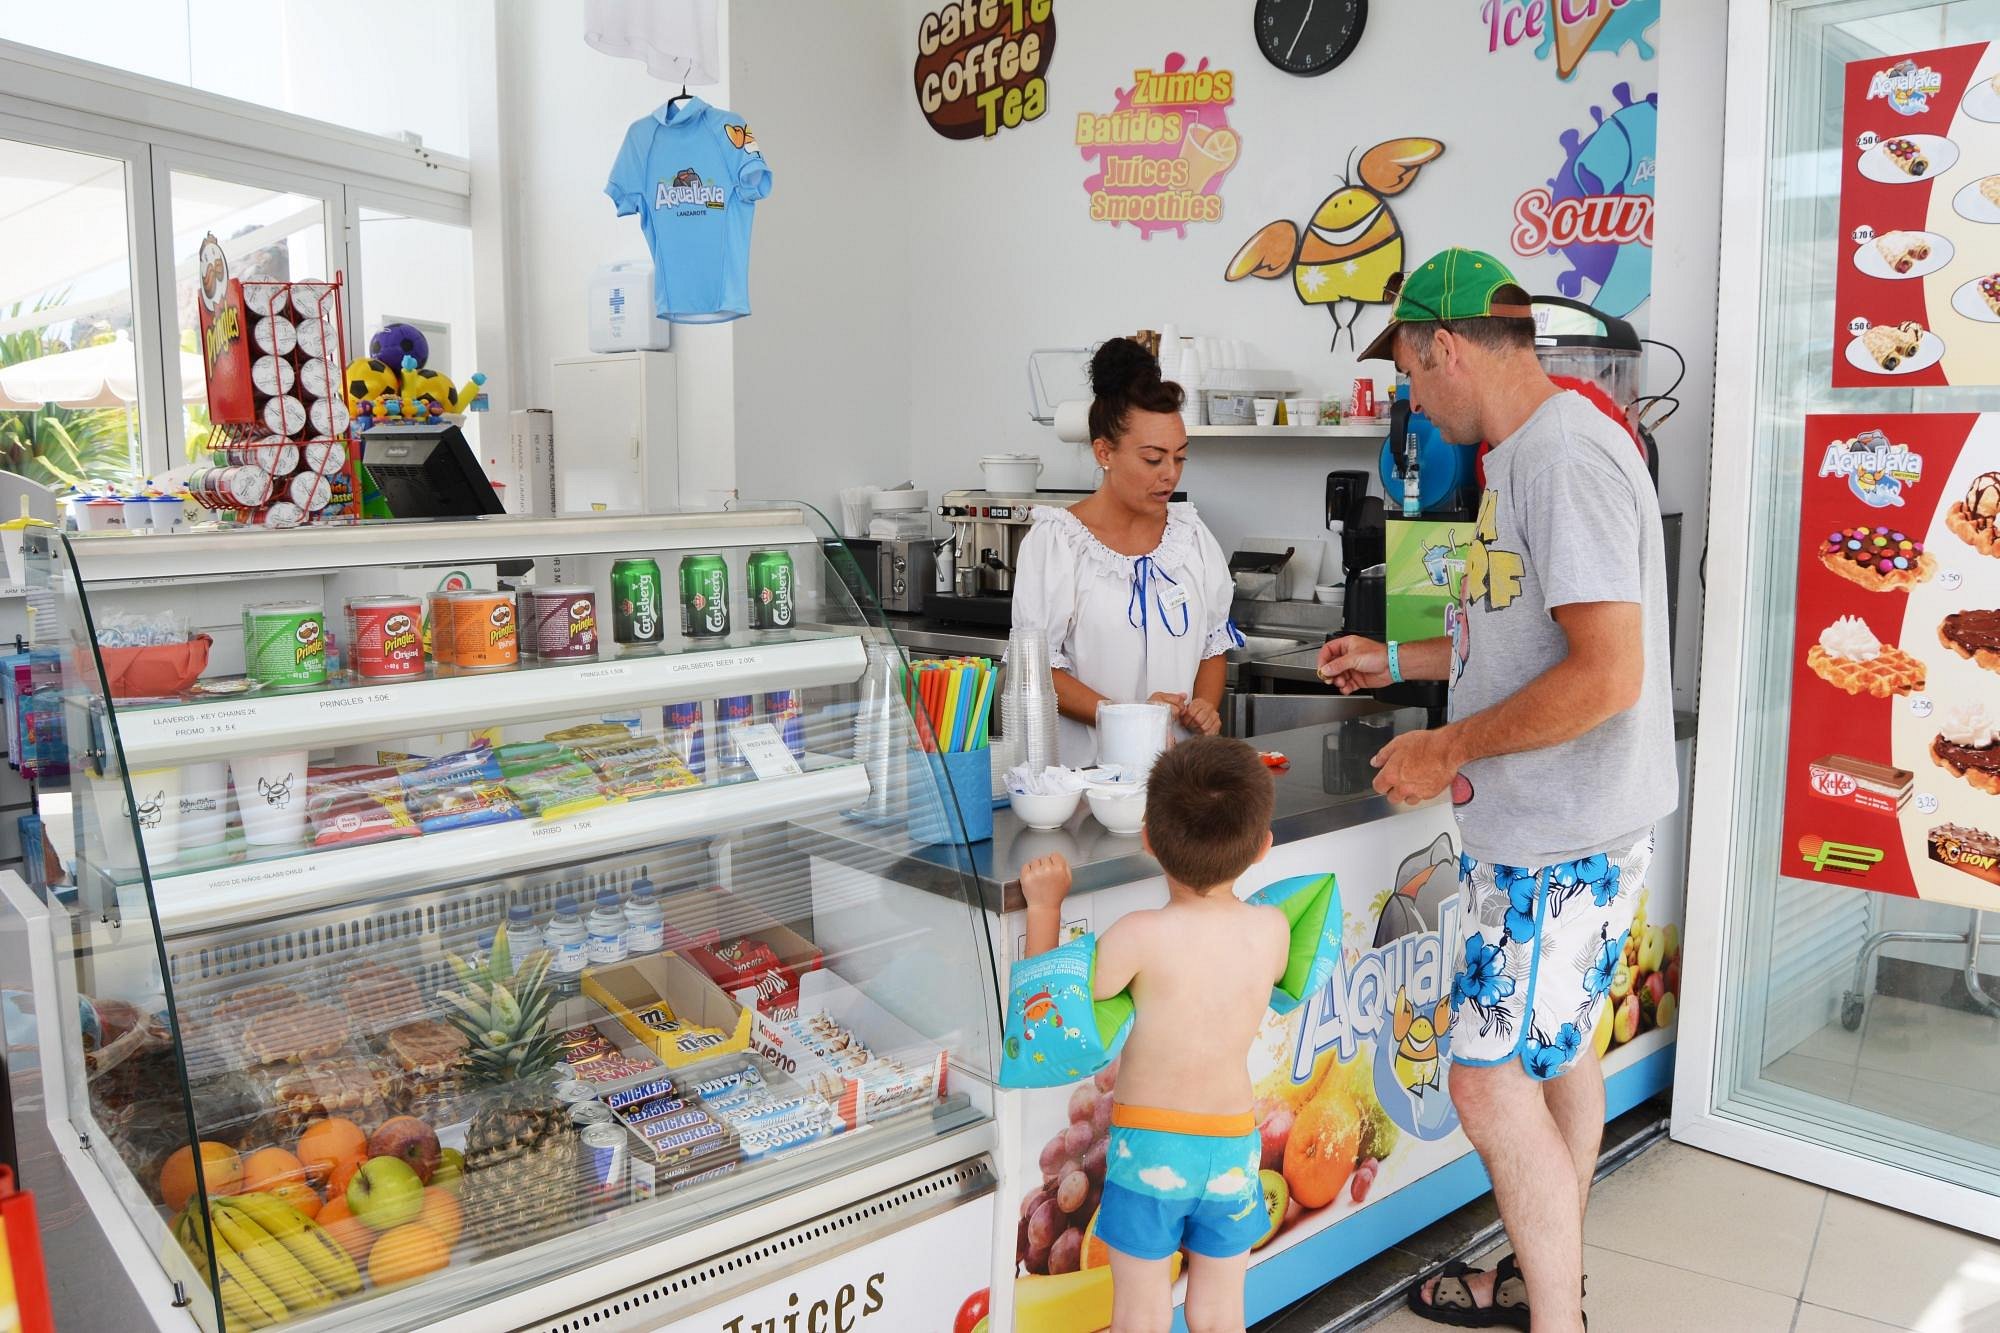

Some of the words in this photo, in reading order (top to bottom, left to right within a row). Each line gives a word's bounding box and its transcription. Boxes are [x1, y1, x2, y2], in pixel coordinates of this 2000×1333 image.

[1345, 2, 1351, 12] 3
[1268, 16, 1274, 26] 9
[1273, 36, 1279, 46] 8
[1325, 44, 1331, 54] 5
[1306, 54, 1312, 64] 6
[921, 33, 1041, 114] coffee
[1132, 69, 1234, 105] Zumos
[976, 77, 1047, 137] Tea
[1075, 110, 1182, 145] Batidos
[1104, 155, 1190, 187] Juices
[1091, 190, 1222, 222] Smoothies
[206, 300, 240, 379] Pringles
[634, 574, 657, 639] Carlsberg
[706, 570, 727, 633] Carlsberg
[772, 565, 793, 627] Carlsberg
[384, 633, 416, 656] Pringles
[672, 661, 714, 672] CARLSBERG
[319, 696, 364, 709] PRINGLES
[153, 715, 195, 725] LLAVEROS
[200, 711, 215, 720] KEY
[217, 709, 247, 719] CHAINS
[175, 727, 205, 737] PROMO
[1819, 773, 1852, 795] KitKat
[532, 826, 562, 838] HARIBO
[758, 1019, 785, 1048] kinder
[610, 1080, 672, 1108] SNICKERS
[645, 1111, 708, 1137] SNICKERS
[659, 1123, 722, 1150] SNICKERS
